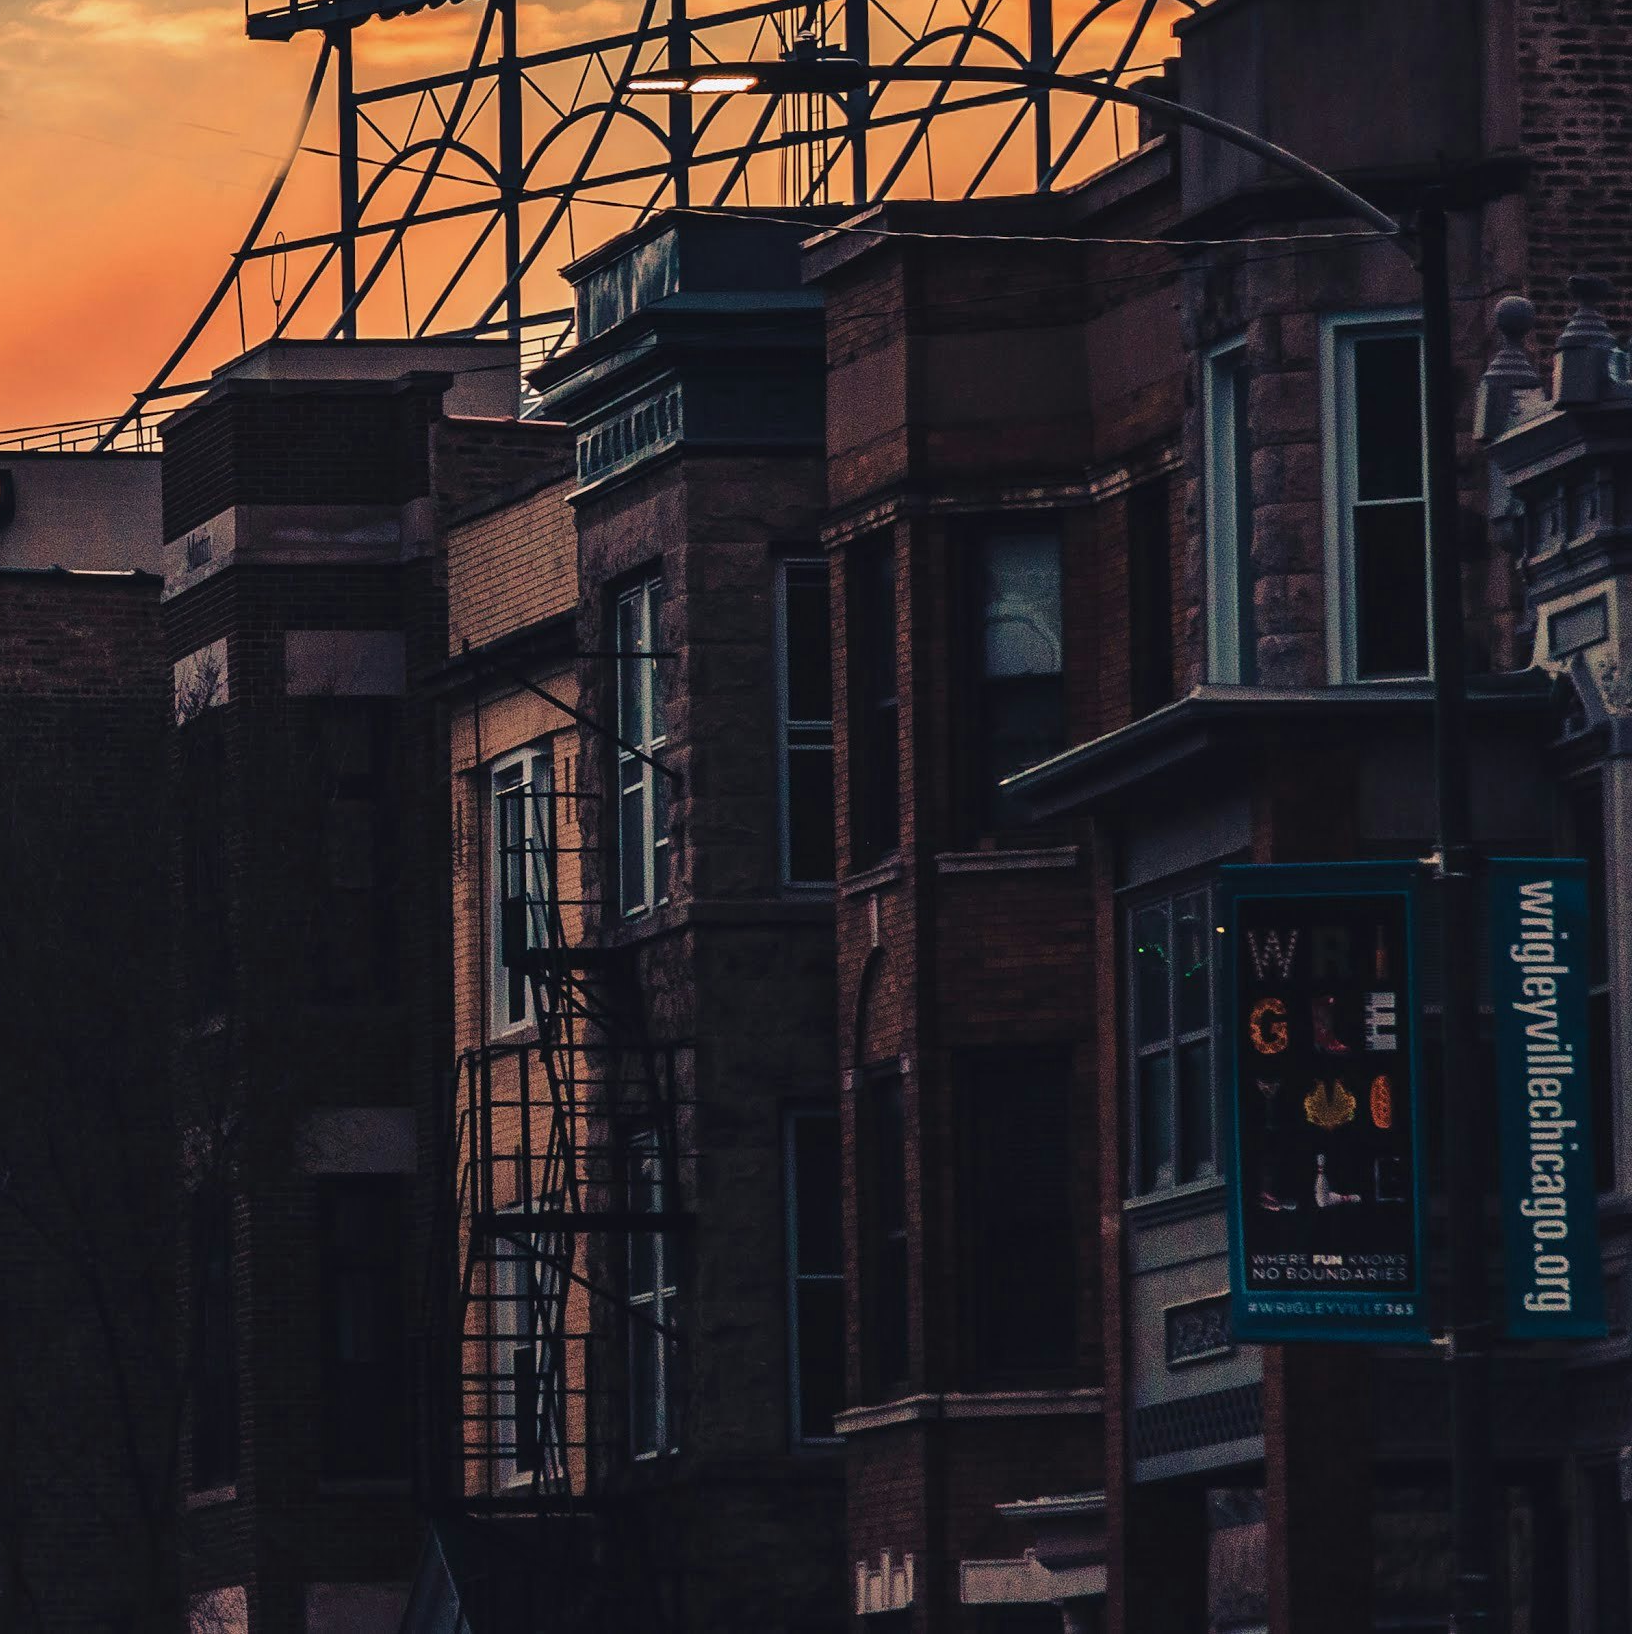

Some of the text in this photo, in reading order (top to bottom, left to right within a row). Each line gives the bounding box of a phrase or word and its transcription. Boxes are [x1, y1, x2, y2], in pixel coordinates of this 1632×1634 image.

[1510, 879, 1578, 1313] wrigleyvillechicago.org
[1251, 1253, 1409, 1266] WHERE FUN KNOWS
[1251, 1267, 1409, 1282] NO BOUNDARIES
